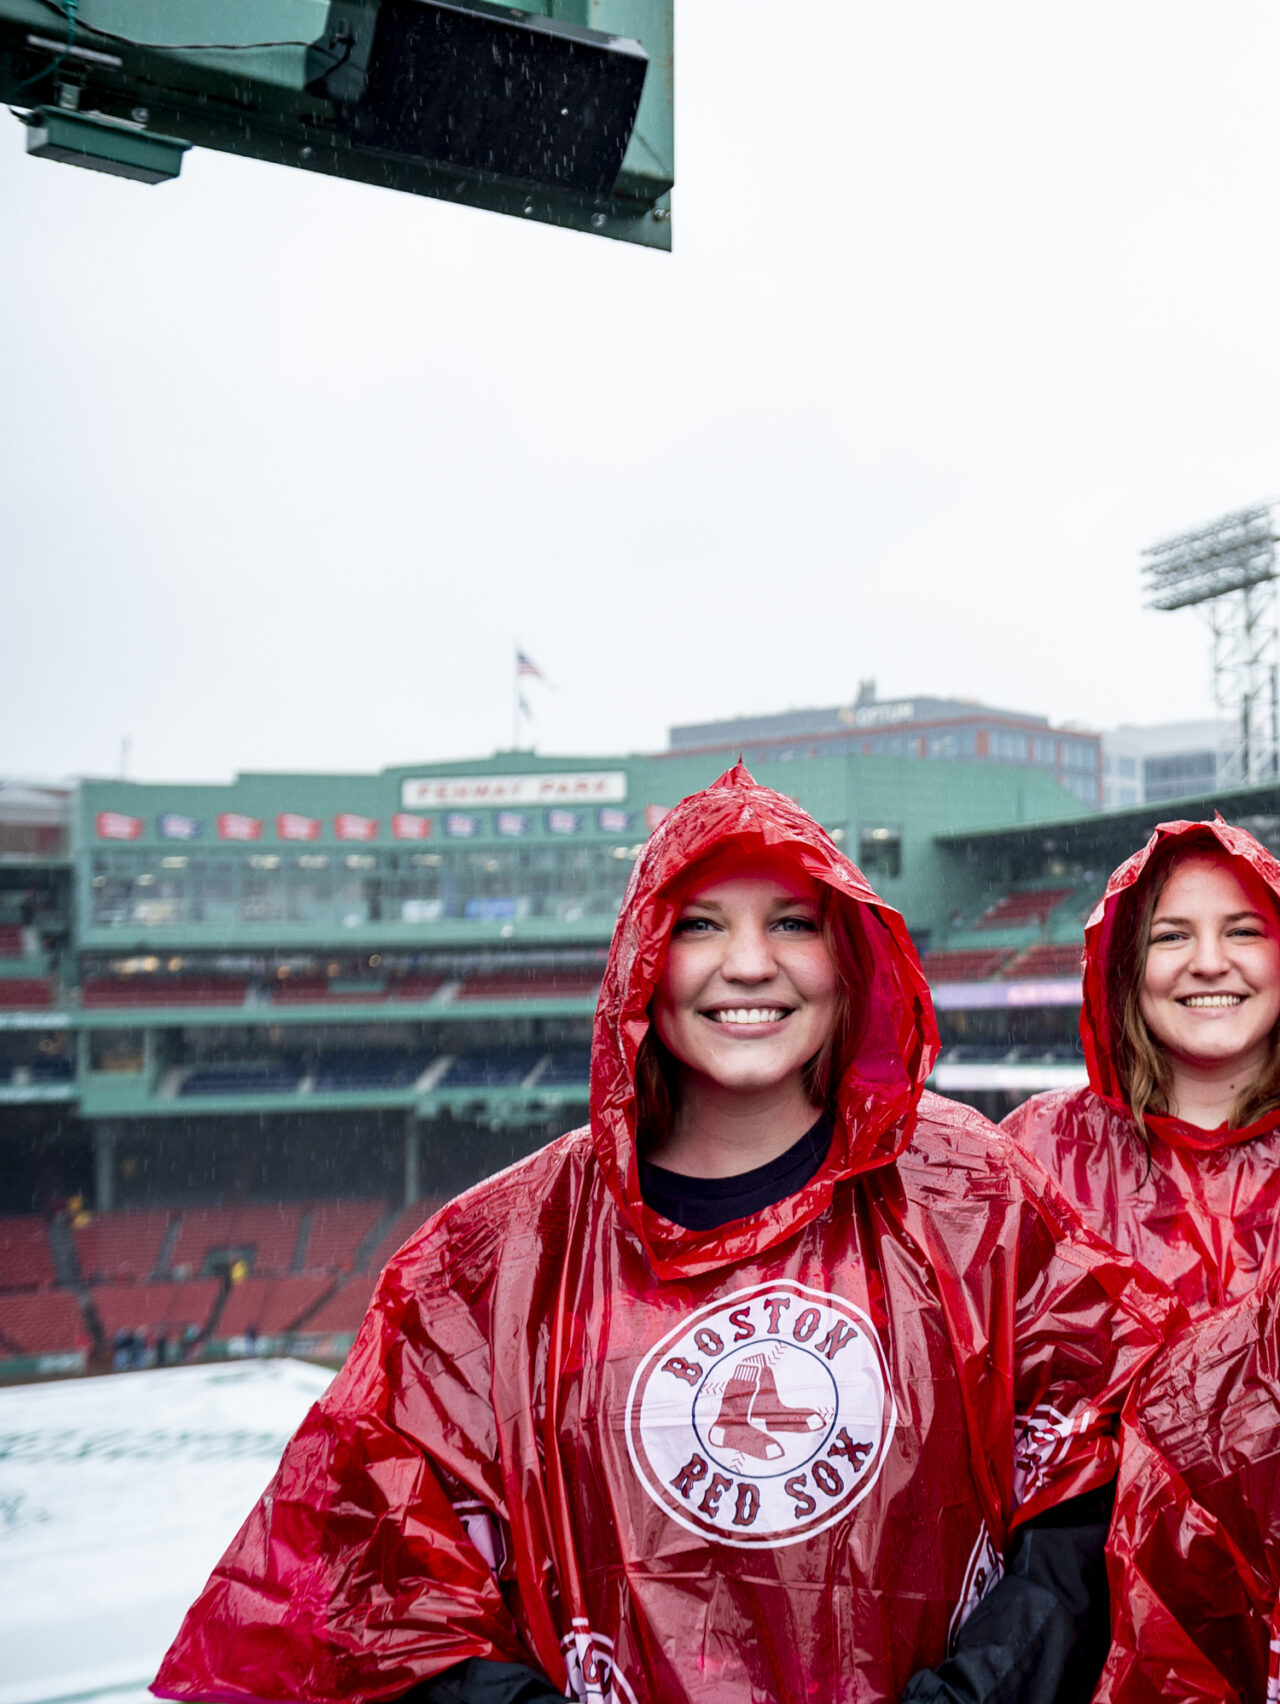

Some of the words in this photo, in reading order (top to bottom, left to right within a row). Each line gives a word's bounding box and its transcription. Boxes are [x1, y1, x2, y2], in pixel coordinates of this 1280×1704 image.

[661, 1297, 858, 1387] BOSTON
[669, 1452, 760, 1526] RED
[784, 1426, 874, 1519] SOX
